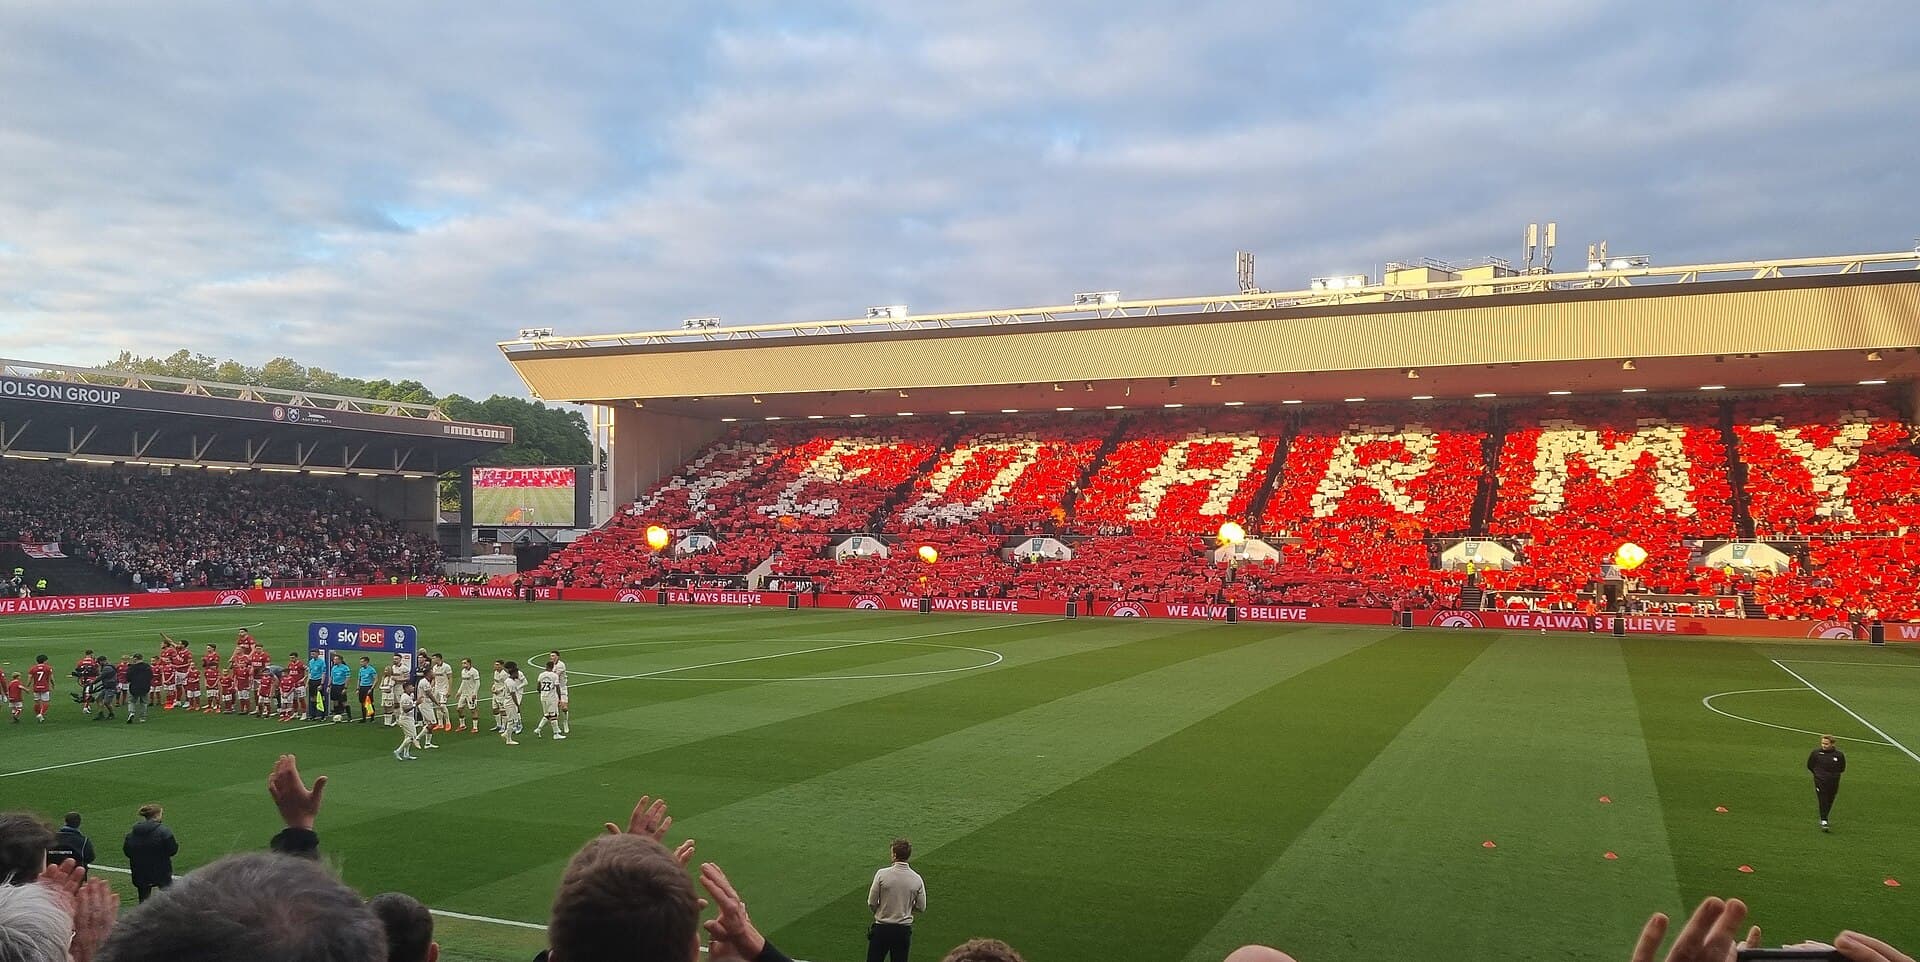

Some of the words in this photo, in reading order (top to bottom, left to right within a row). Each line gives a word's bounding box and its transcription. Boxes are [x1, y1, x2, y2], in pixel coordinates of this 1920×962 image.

[66, 387, 120, 404] GROUP
[264, 590, 282, 600] WE
[283, 588, 325, 599] ALWAYS
[326, 587, 363, 597] BELIEVE
[721, 593, 761, 603] BELIEVE
[855, 595, 880, 604] BRISTOL
[18, 599, 76, 611] ALWAYS
[79, 597, 130, 609] BELIEVE
[900, 598, 918, 609] WE
[971, 600, 1018, 611] BELIEVE
[1112, 602, 1142, 612] BRISTOL
[1167, 605, 1188, 617] WE
[1251, 608, 1307, 620] BELIEVE
[1439, 610, 1475, 622] BRISTOL
[1503, 614, 1530, 627] WE
[338, 628, 358, 646] sky
[361, 630, 383, 643] bet
[36, 671, 45, 682] 7
[541, 681, 552, 692] 23
